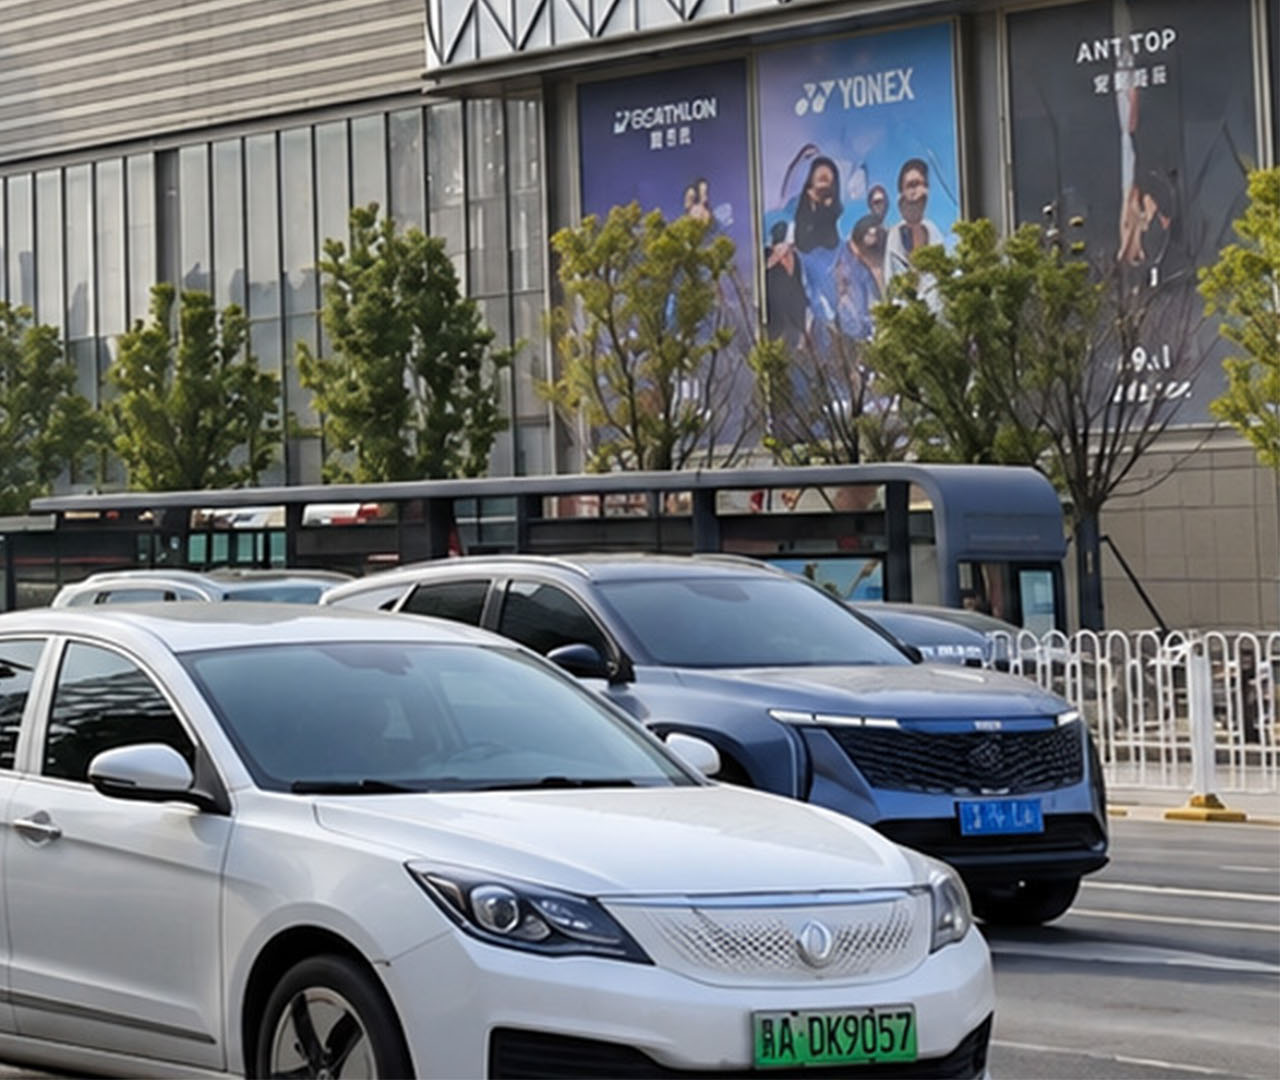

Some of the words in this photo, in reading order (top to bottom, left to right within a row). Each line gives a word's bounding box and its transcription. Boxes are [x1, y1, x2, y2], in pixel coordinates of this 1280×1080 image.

[1076, 37, 1121, 64] ANT
[1129, 27, 1177, 54] TOP
[838, 67, 915, 110] YONEX
